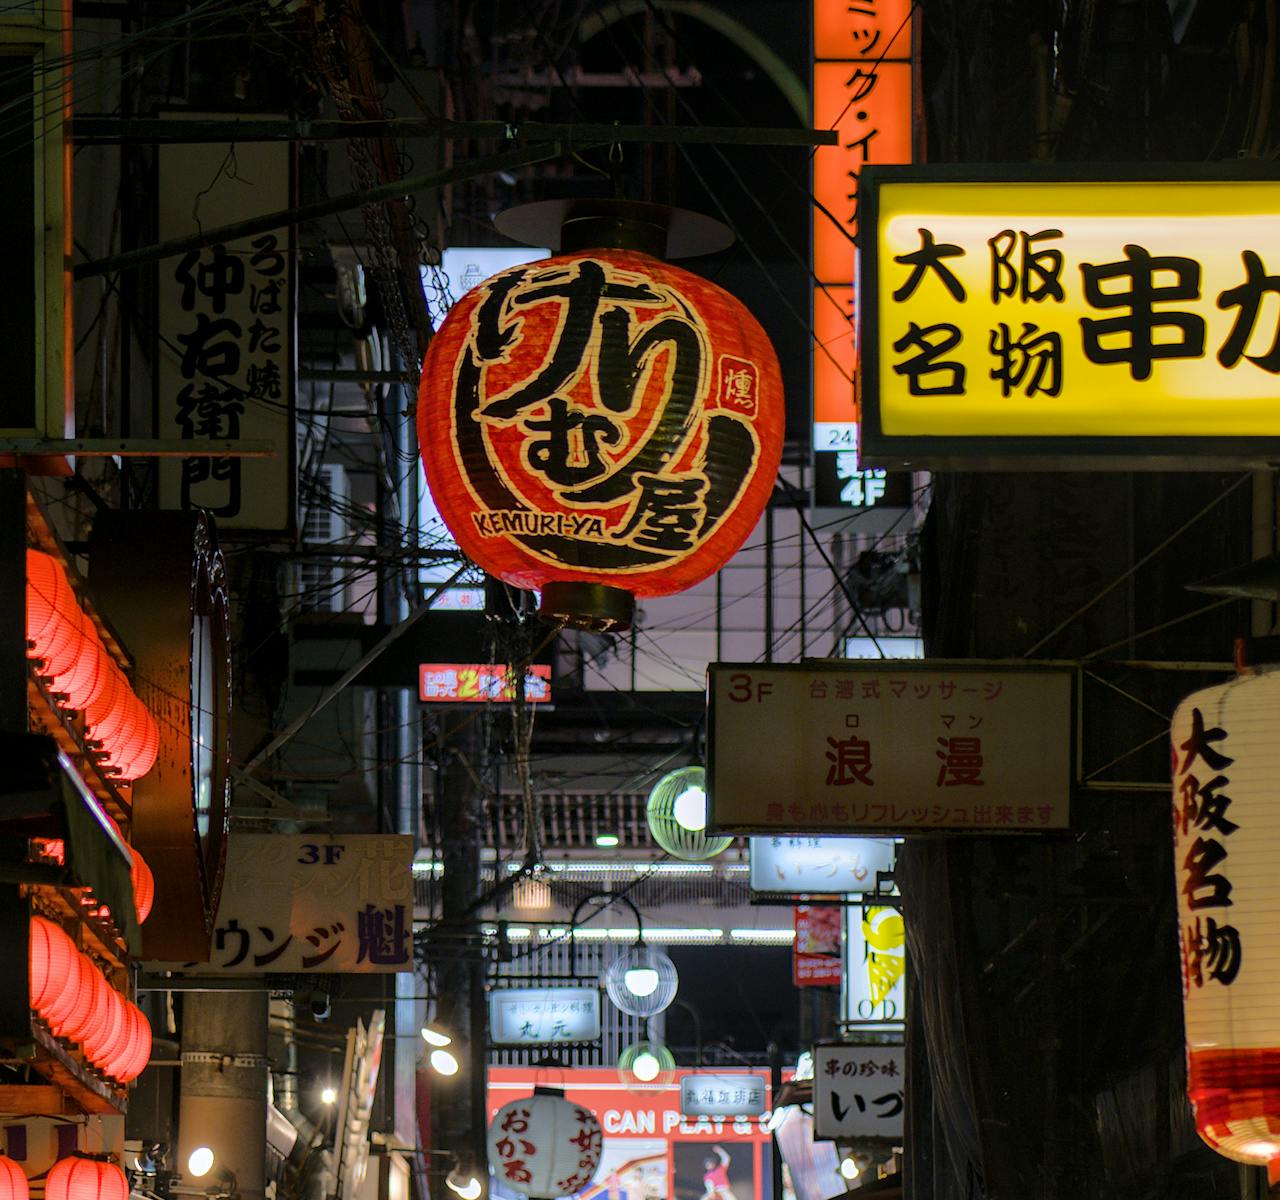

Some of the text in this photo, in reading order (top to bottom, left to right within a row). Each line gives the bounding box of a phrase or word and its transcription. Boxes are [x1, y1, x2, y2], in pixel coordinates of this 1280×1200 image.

[892, 229, 1065, 305] 大阪
[246, 234, 287, 400] ろばた焼
[892, 322, 1065, 398] 名物
[841, 479, 886, 506] 4F
[473, 510, 605, 538] KEMURI-YA
[728, 673, 774, 703] 3F
[825, 736, 985, 788] 浪漫
[297, 844, 345, 865] 3F
[1180, 708, 1241, 986] 大阪名物
[183, 904, 410, 968] ウンジ 魁
[603, 1109, 656, 1134] CAN
[663, 1109, 727, 1134] PLAY
